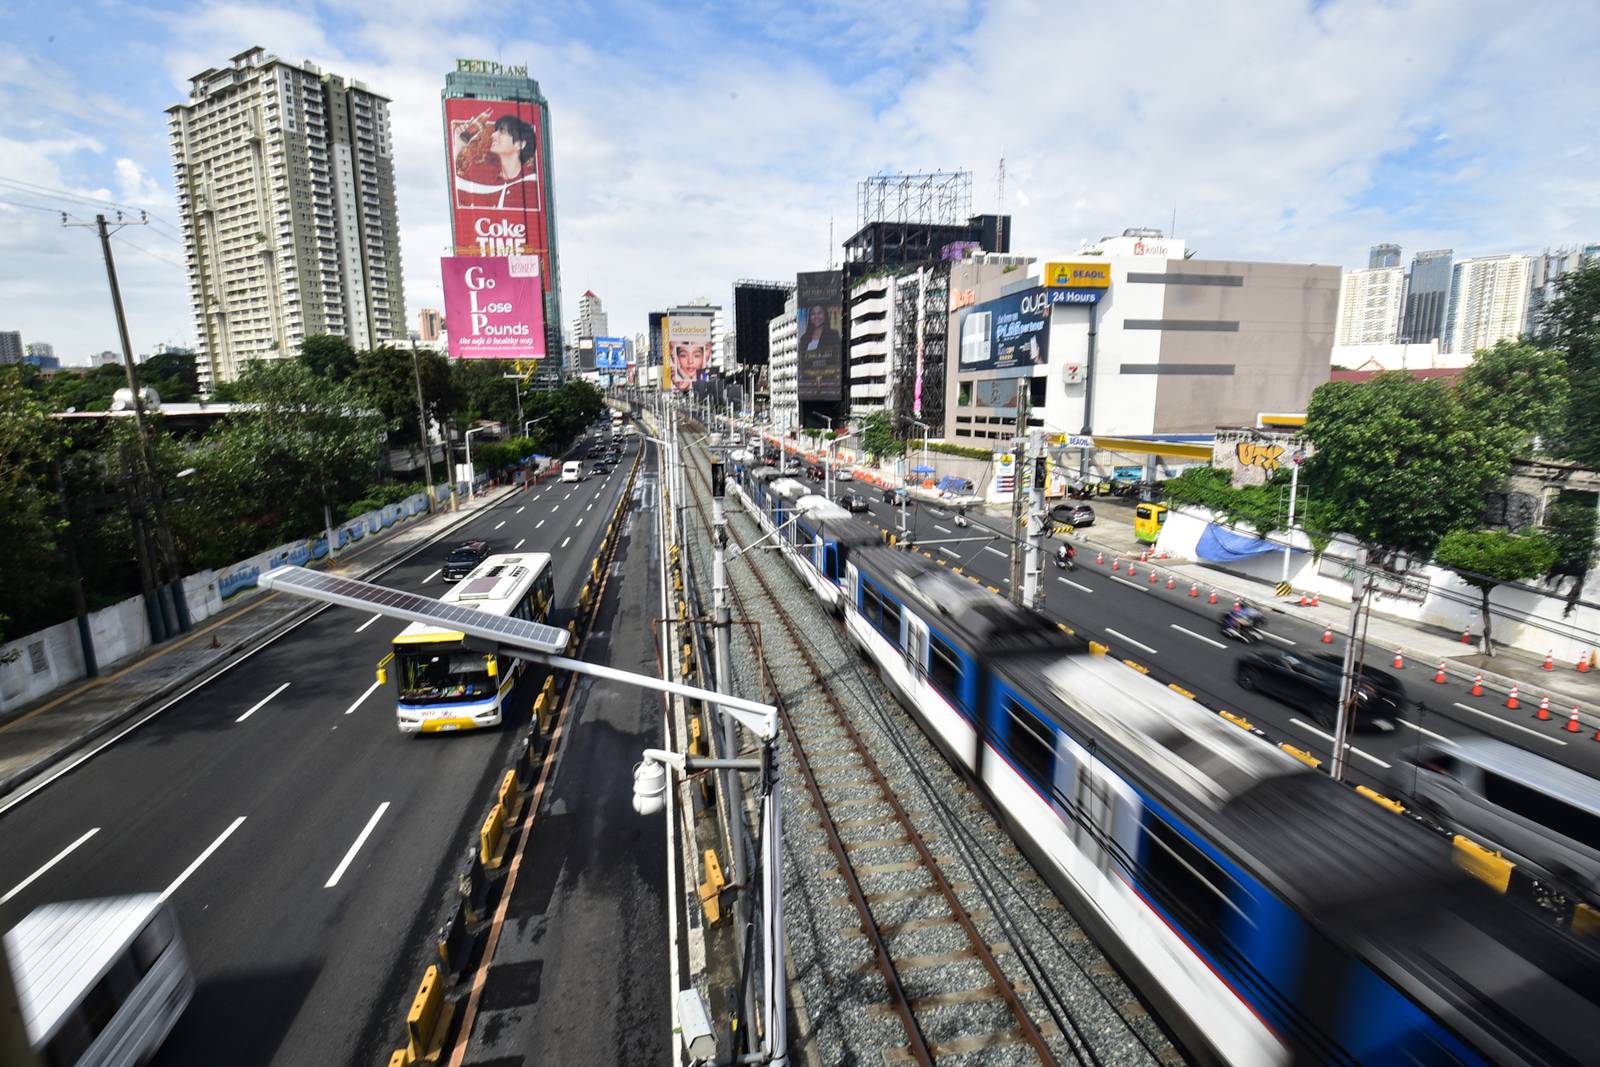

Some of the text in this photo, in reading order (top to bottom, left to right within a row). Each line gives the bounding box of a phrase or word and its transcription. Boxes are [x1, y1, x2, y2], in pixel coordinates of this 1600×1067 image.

[474, 217, 526, 237] Coke
[476, 237, 526, 257] TIME
[465, 266, 495, 290] Go
[1073, 270, 1105, 278] SEAOIL
[470, 290, 512, 313] Lose
[1052, 291, 1096, 302] 24 Hours
[471, 313, 529, 336] Pounds
[459, 336, 471, 344] the
[471, 336, 486, 345] safe
[493, 336, 519, 346] healthy
[519, 337, 534, 346] way
